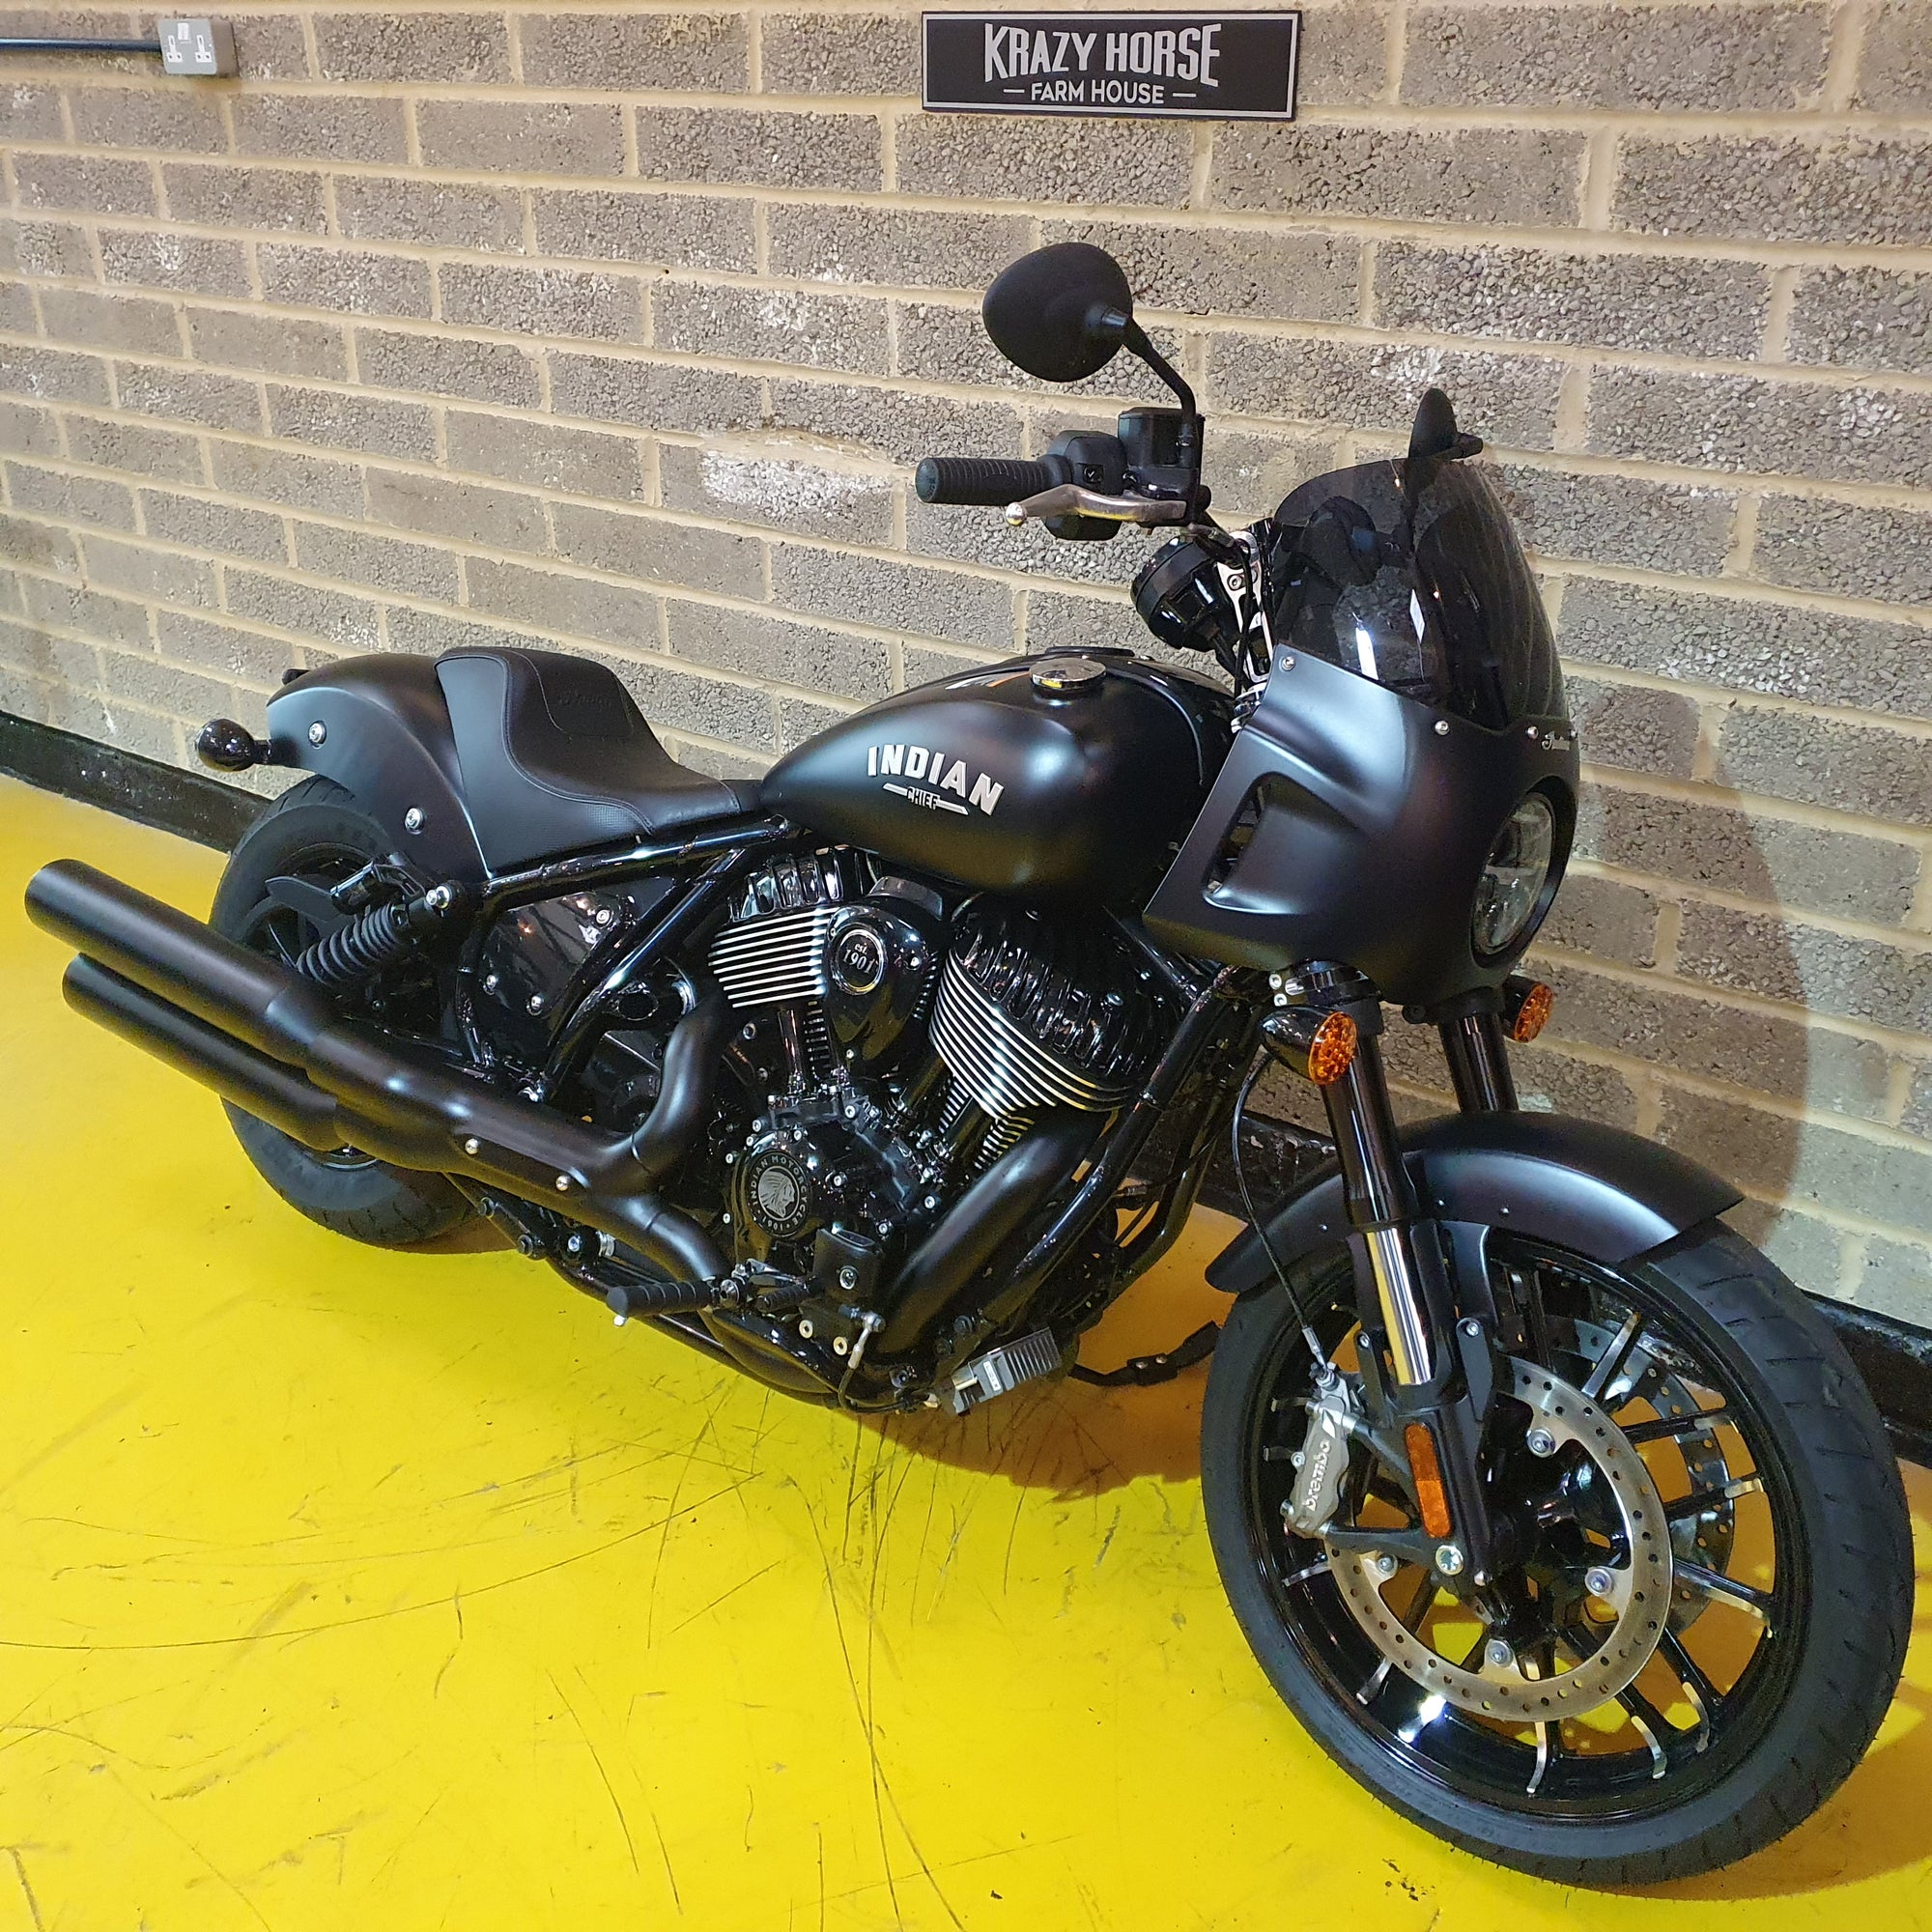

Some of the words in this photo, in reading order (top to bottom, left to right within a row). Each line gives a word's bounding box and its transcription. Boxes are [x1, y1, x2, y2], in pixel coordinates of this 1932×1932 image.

[984, 22, 1097, 83] KRAZY
[1105, 23, 1222, 88] HORSE
[1031, 80, 1084, 102] FARM
[1091, 79, 1165, 105] HOUSE
[867, 744, 1005, 816] INDIAN
[907, 786, 940, 810] CHIEF
[842, 949, 876, 974] 1901
[751, 1159, 768, 1206] INDIAN
[771, 1155, 808, 1226] MOTORCYCLE
[1302, 1438, 1331, 1513] brembo
